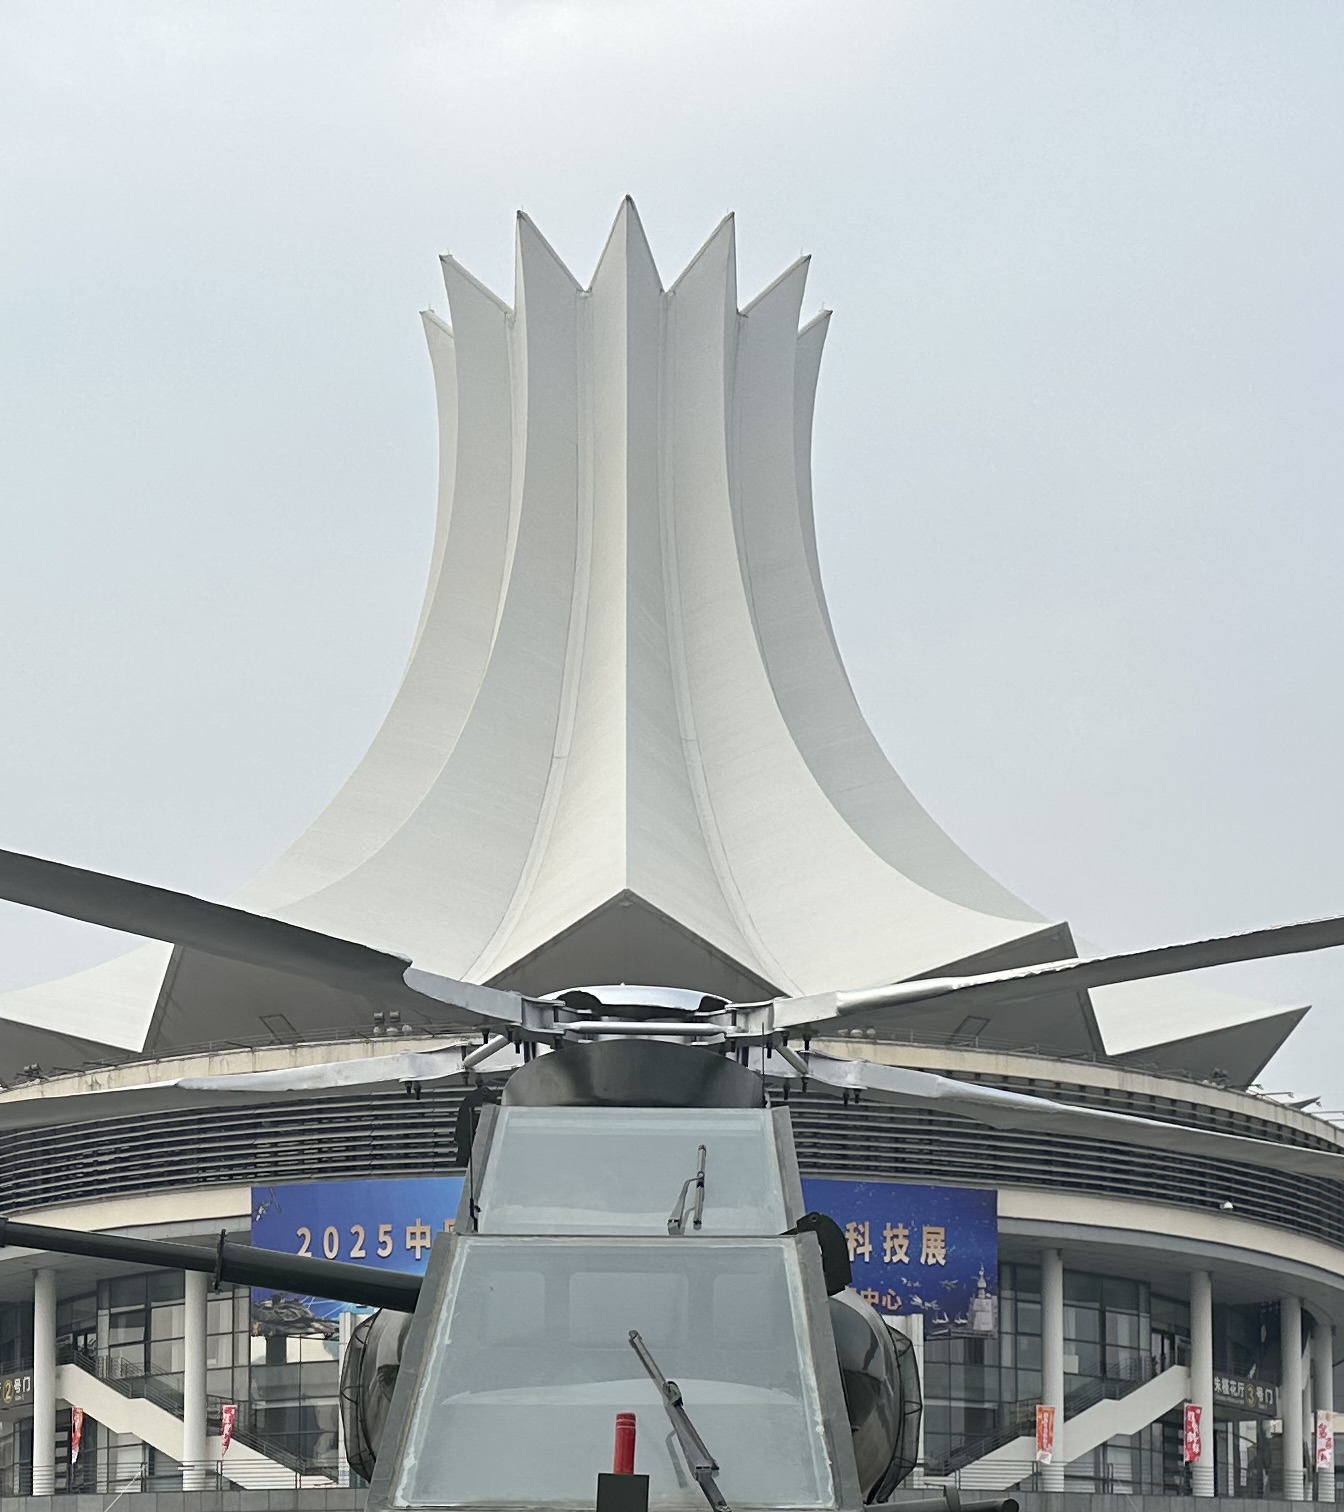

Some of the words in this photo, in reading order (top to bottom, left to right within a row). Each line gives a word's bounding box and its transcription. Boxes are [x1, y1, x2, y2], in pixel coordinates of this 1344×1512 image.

[297, 1218, 455, 1260] 2025中
[845, 1221, 947, 1266] 科技展
